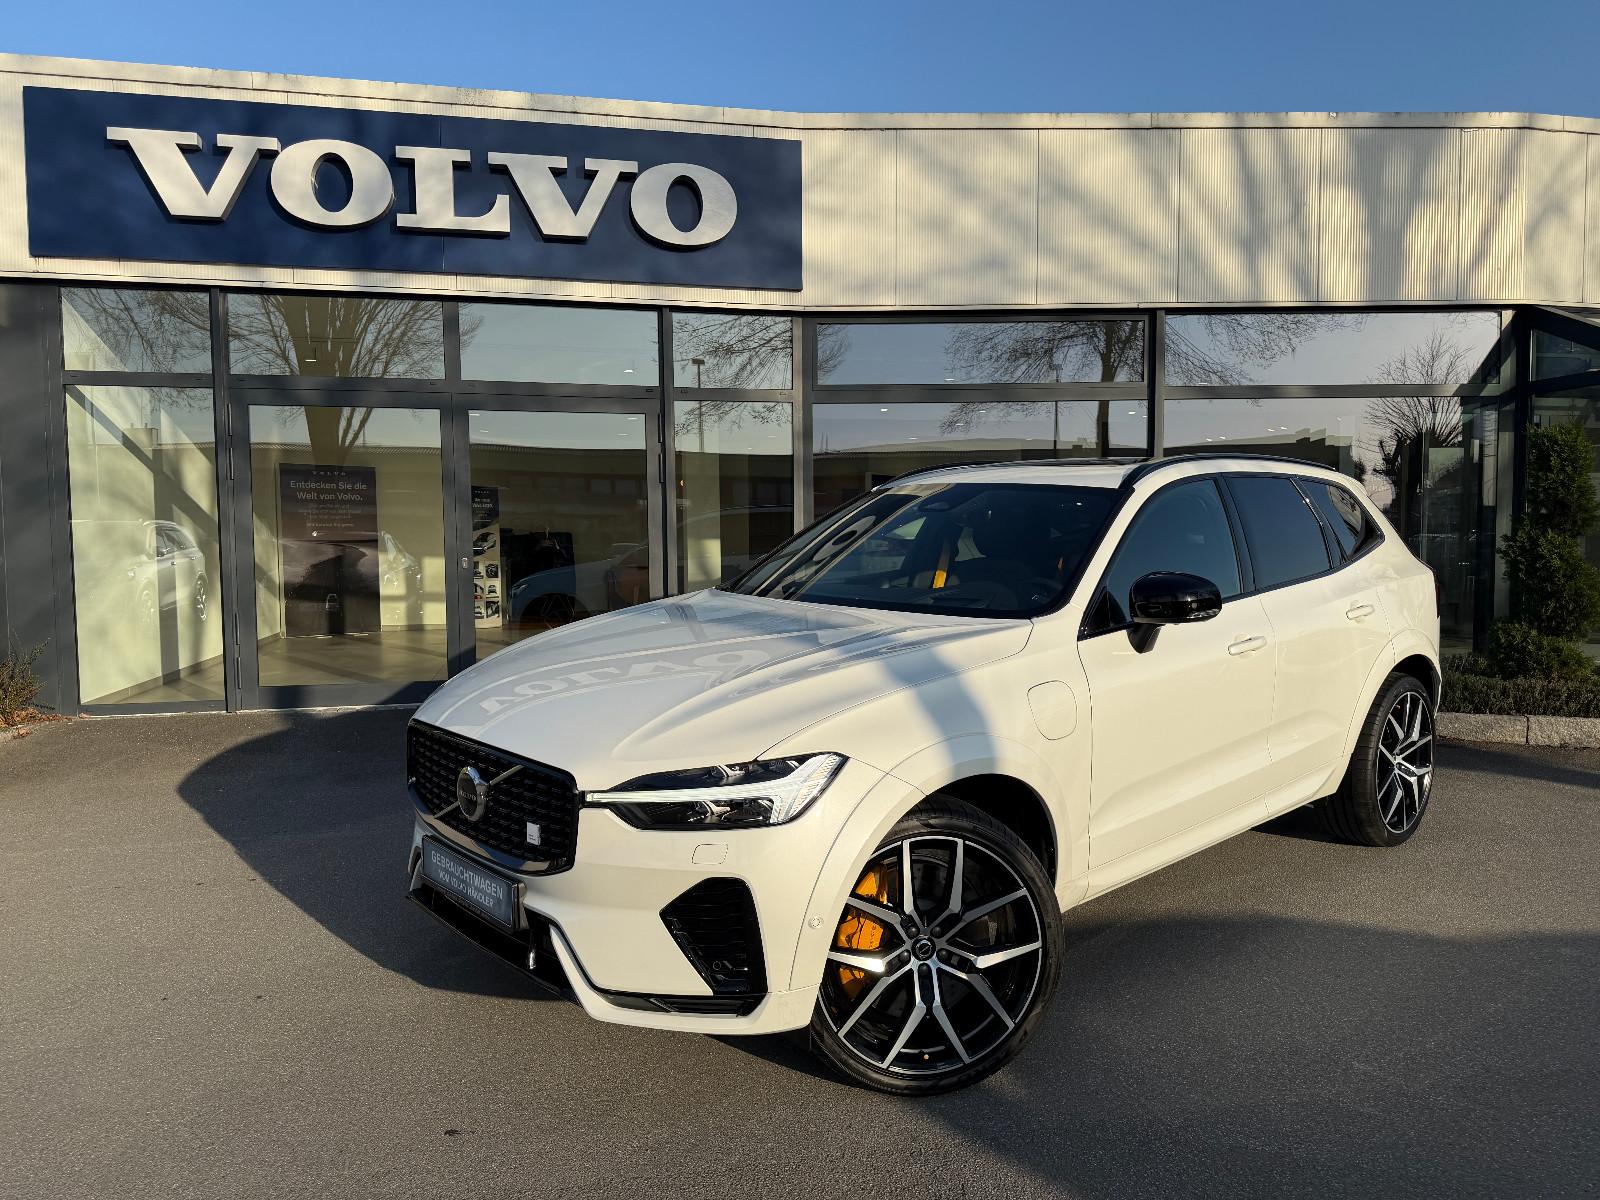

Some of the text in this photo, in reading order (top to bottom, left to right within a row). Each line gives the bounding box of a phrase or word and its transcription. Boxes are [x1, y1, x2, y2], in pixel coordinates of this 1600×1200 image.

[106, 127, 737, 248] VOLVO
[290, 480, 368, 490] Entdecken Sie die
[296, 491, 318, 500] Welt
[337, 492, 363, 501] Volvo.
[431, 850, 503, 900] GEBRAUCHTWAGEN
